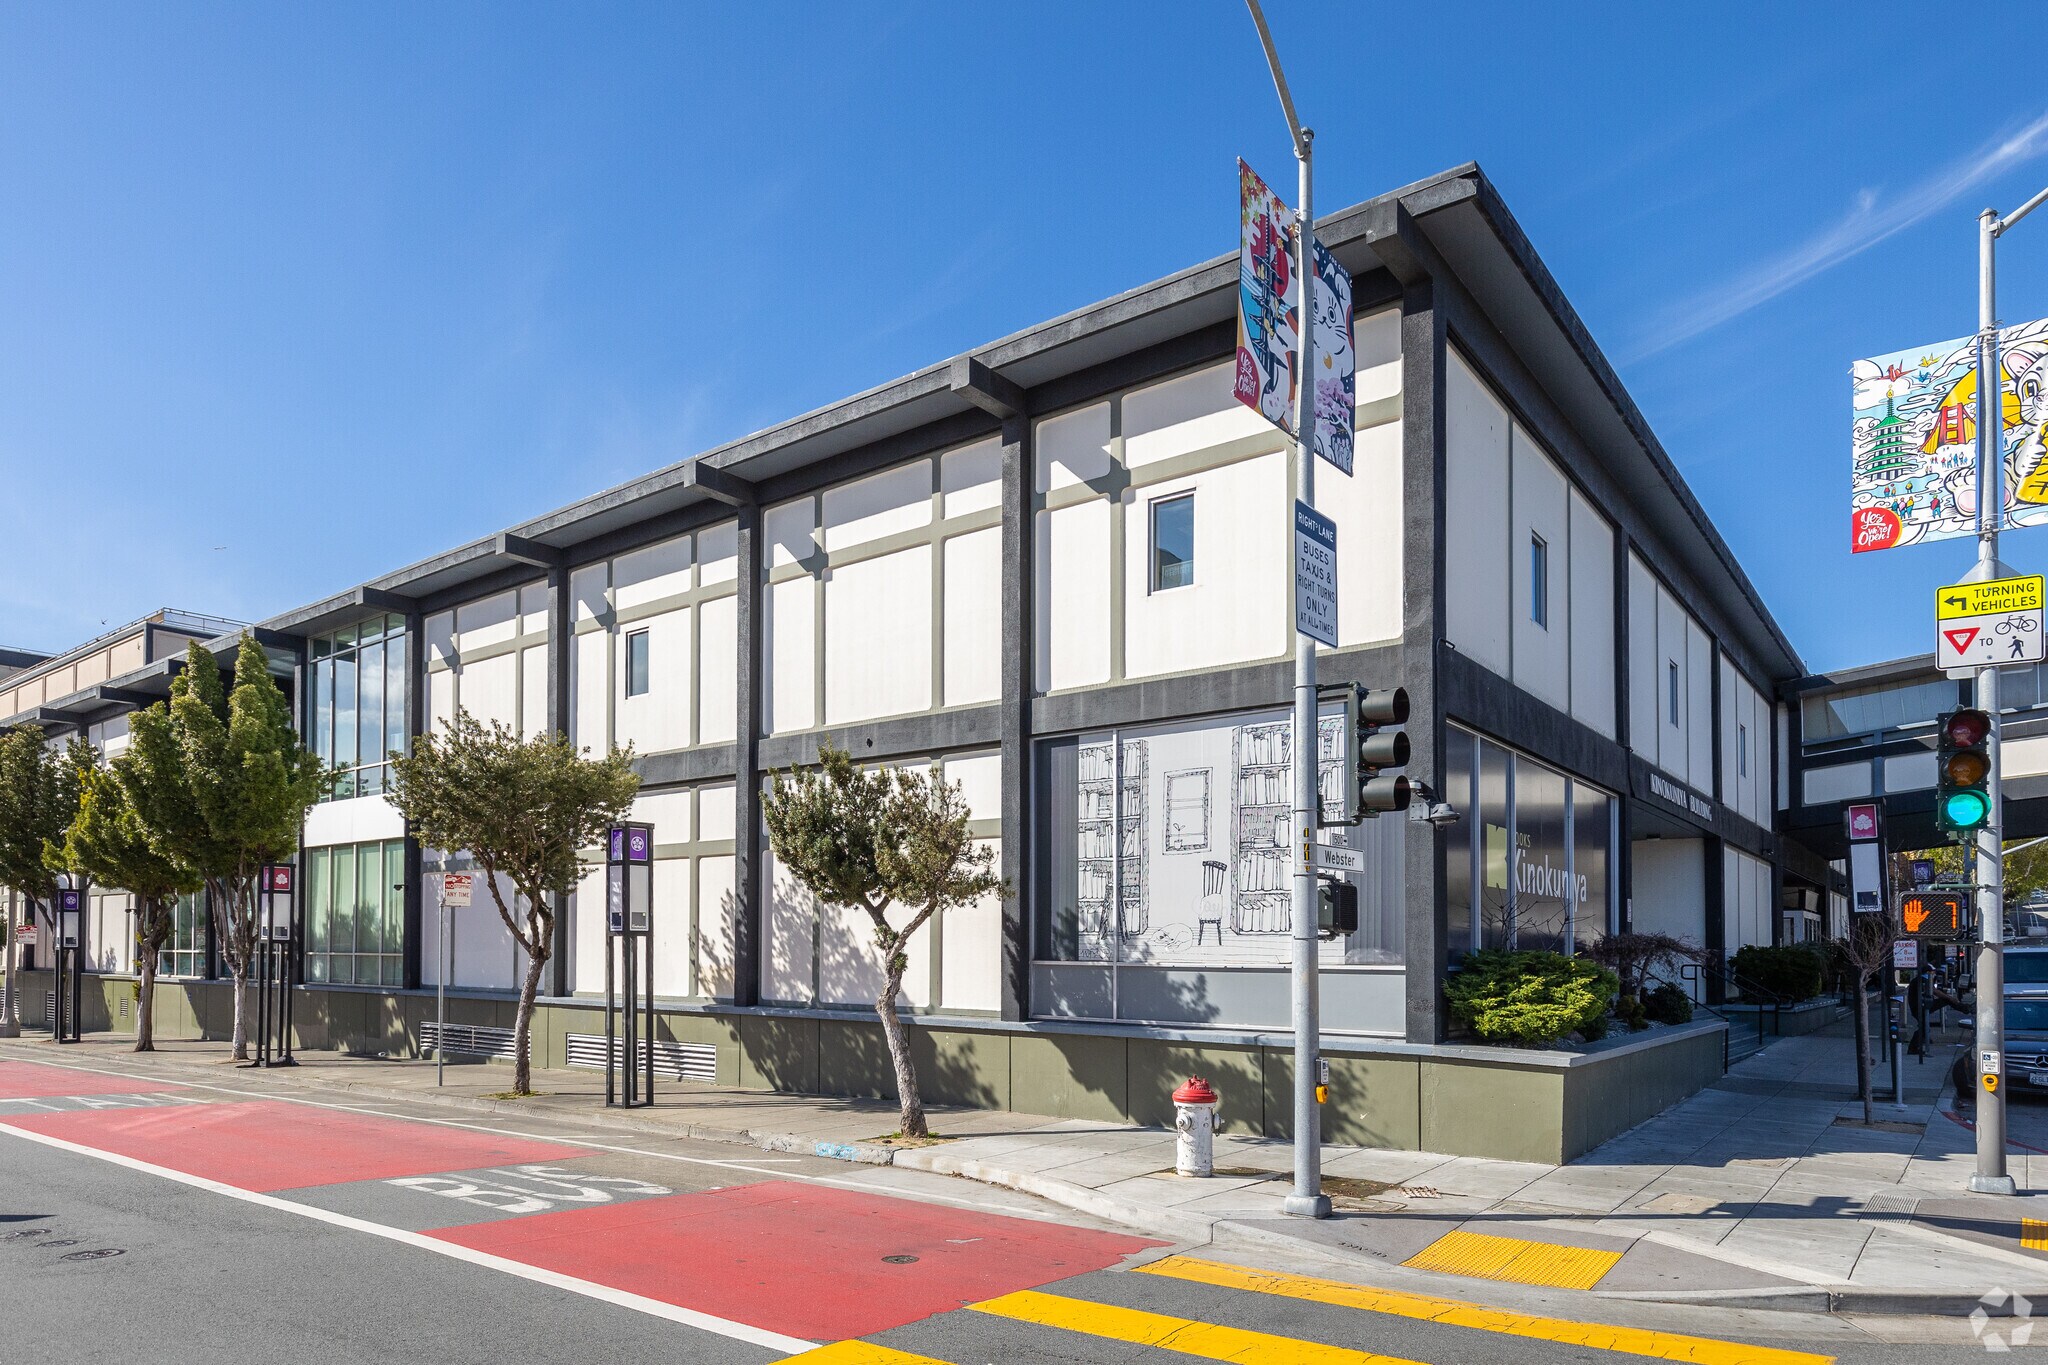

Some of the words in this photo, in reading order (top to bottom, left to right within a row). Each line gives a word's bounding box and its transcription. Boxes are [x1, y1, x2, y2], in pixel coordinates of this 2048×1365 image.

[1298, 512, 1315, 531] RIGHT
[1318, 525, 1334, 542] LANE
[1860, 511, 1887, 530] Yes
[1303, 541, 1329, 565] BUSES
[1301, 558, 1325, 580] TAXIS
[1326, 572, 1332, 584] &
[1297, 574, 1315, 596] RIGHT
[1317, 584, 1335, 604] TURNS
[1974, 582, 2035, 599] TURNING
[1306, 596, 1328, 618] ONLY
[1972, 595, 2037, 612] VEHICLES
[1300, 612, 1307, 624] AT
[1308, 615, 1319, 630] ALL
[1319, 619, 1334, 637] TIMES
[1979, 638, 1994, 647] TO
[1650, 773, 1688, 809] KINOKUNIYA
[1689, 794, 1712, 821] BUILDING
[1324, 850, 1356, 867] Webster
[1515, 848, 1587, 913] Kinokunya
[1944, 901, 1957, 929] 7
[382, 1165, 674, 1213] BUS
